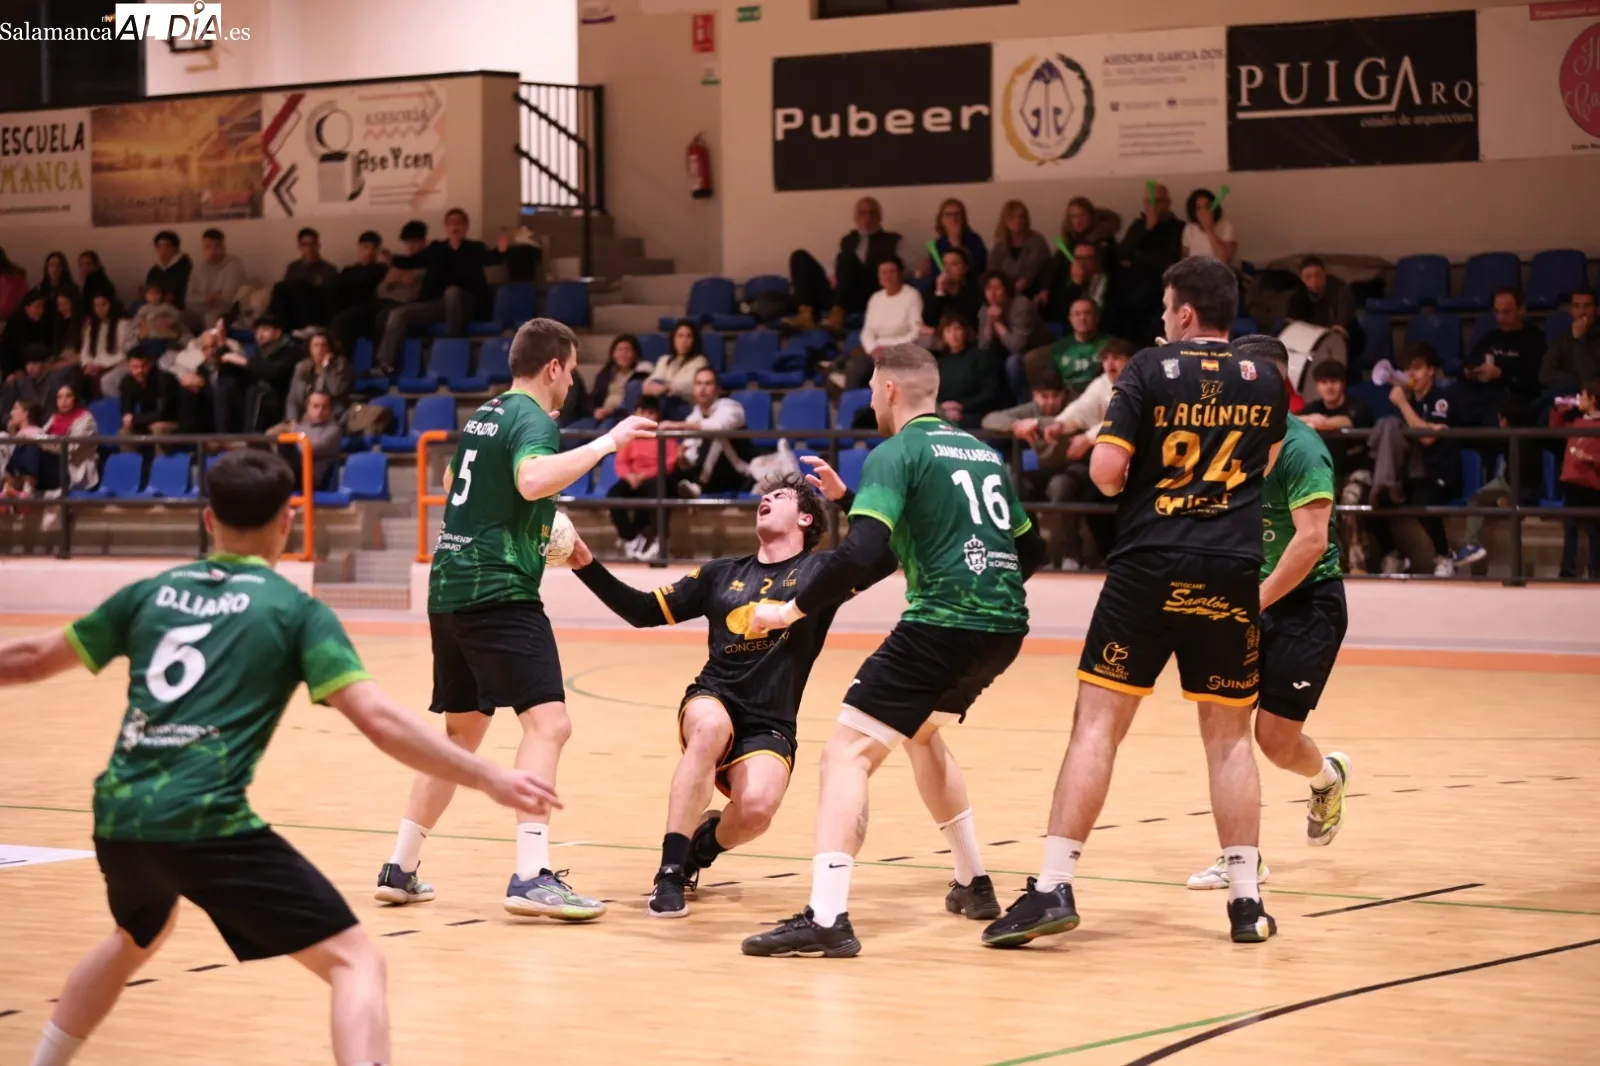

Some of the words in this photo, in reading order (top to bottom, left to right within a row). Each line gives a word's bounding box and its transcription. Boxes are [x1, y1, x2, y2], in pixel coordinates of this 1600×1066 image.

[2, 121, 84, 156] ESCUELA
[774, 103, 990, 142] Pubeer
[1173, 397, 1273, 428] AGÚNDEZ
[450, 448, 478, 506] 5
[1155, 430, 1248, 491] 94
[951, 469, 1011, 530] 16
[759, 577, 773, 594] 2
[146, 623, 213, 703] 6
